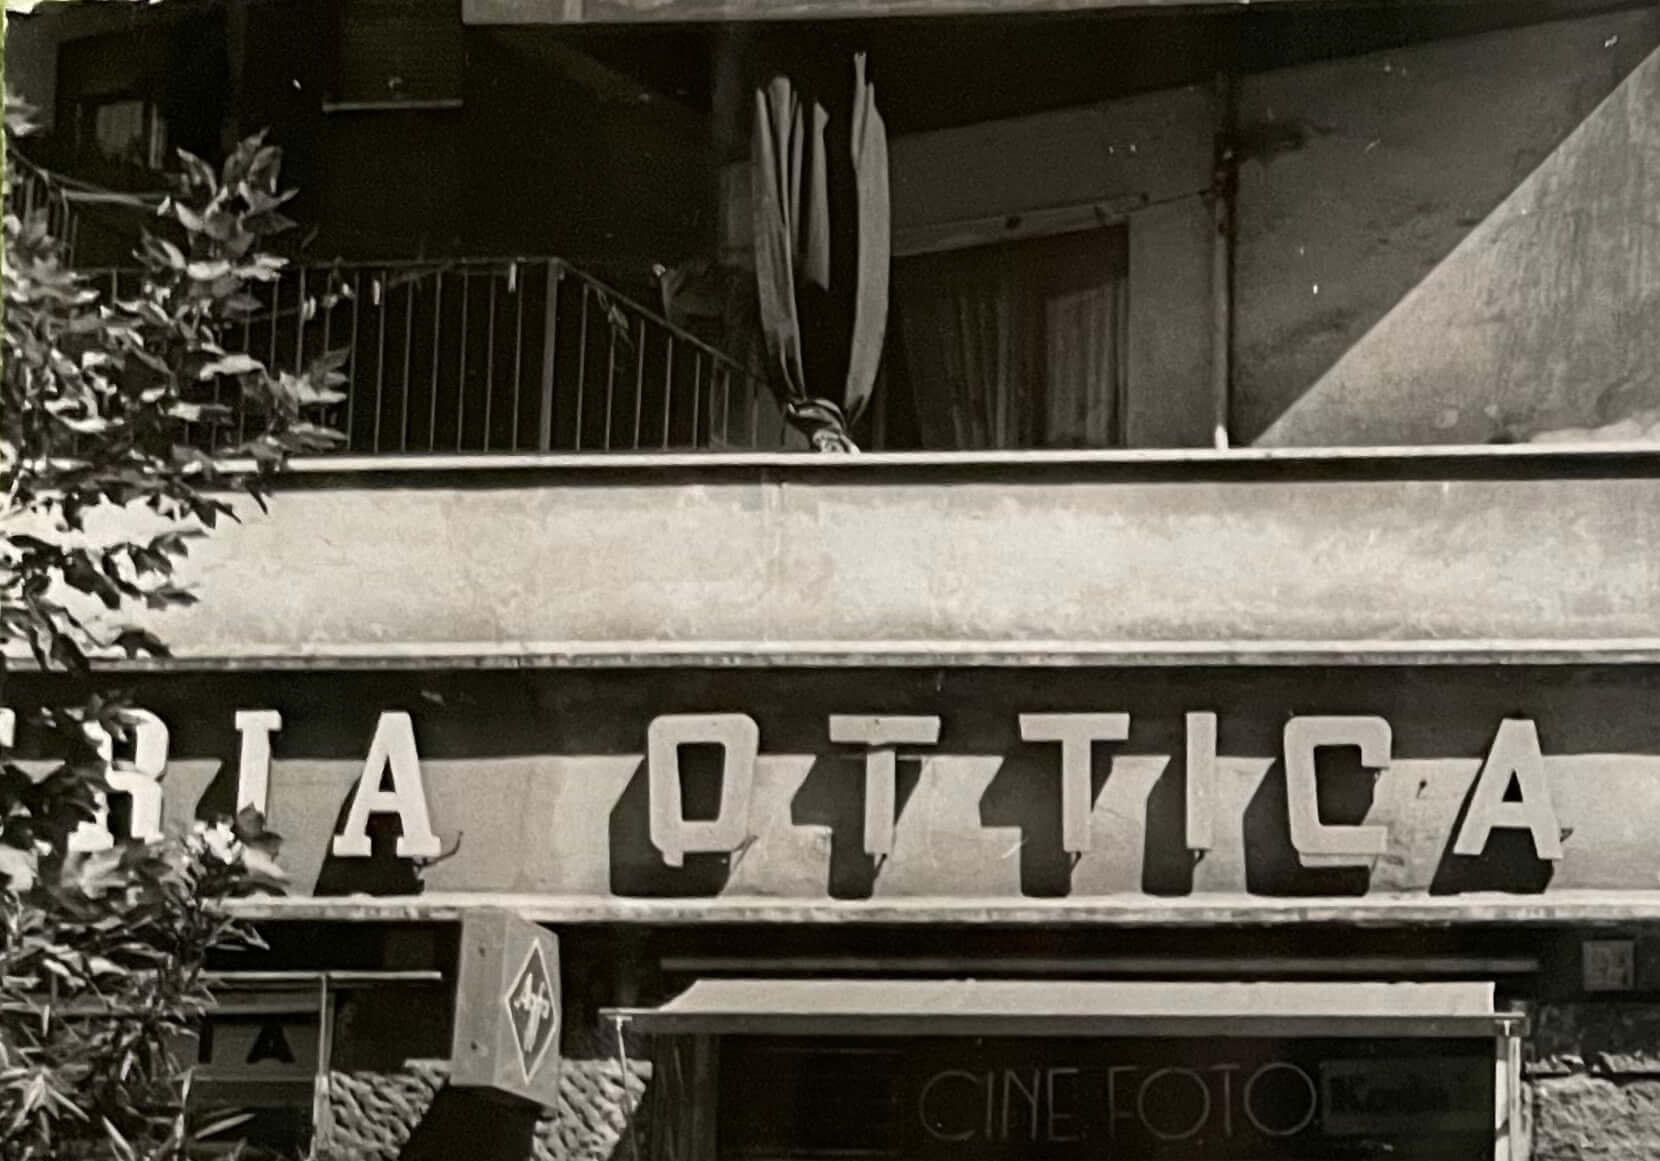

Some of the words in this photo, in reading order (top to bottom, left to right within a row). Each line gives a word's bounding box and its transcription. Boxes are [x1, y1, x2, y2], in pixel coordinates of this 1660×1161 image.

[0, 706, 441, 857] RIA
[647, 711, 1563, 867] OTTICA
[918, 1067, 1079, 1141] CINE
[1107, 1061, 1317, 1140] FOTO
